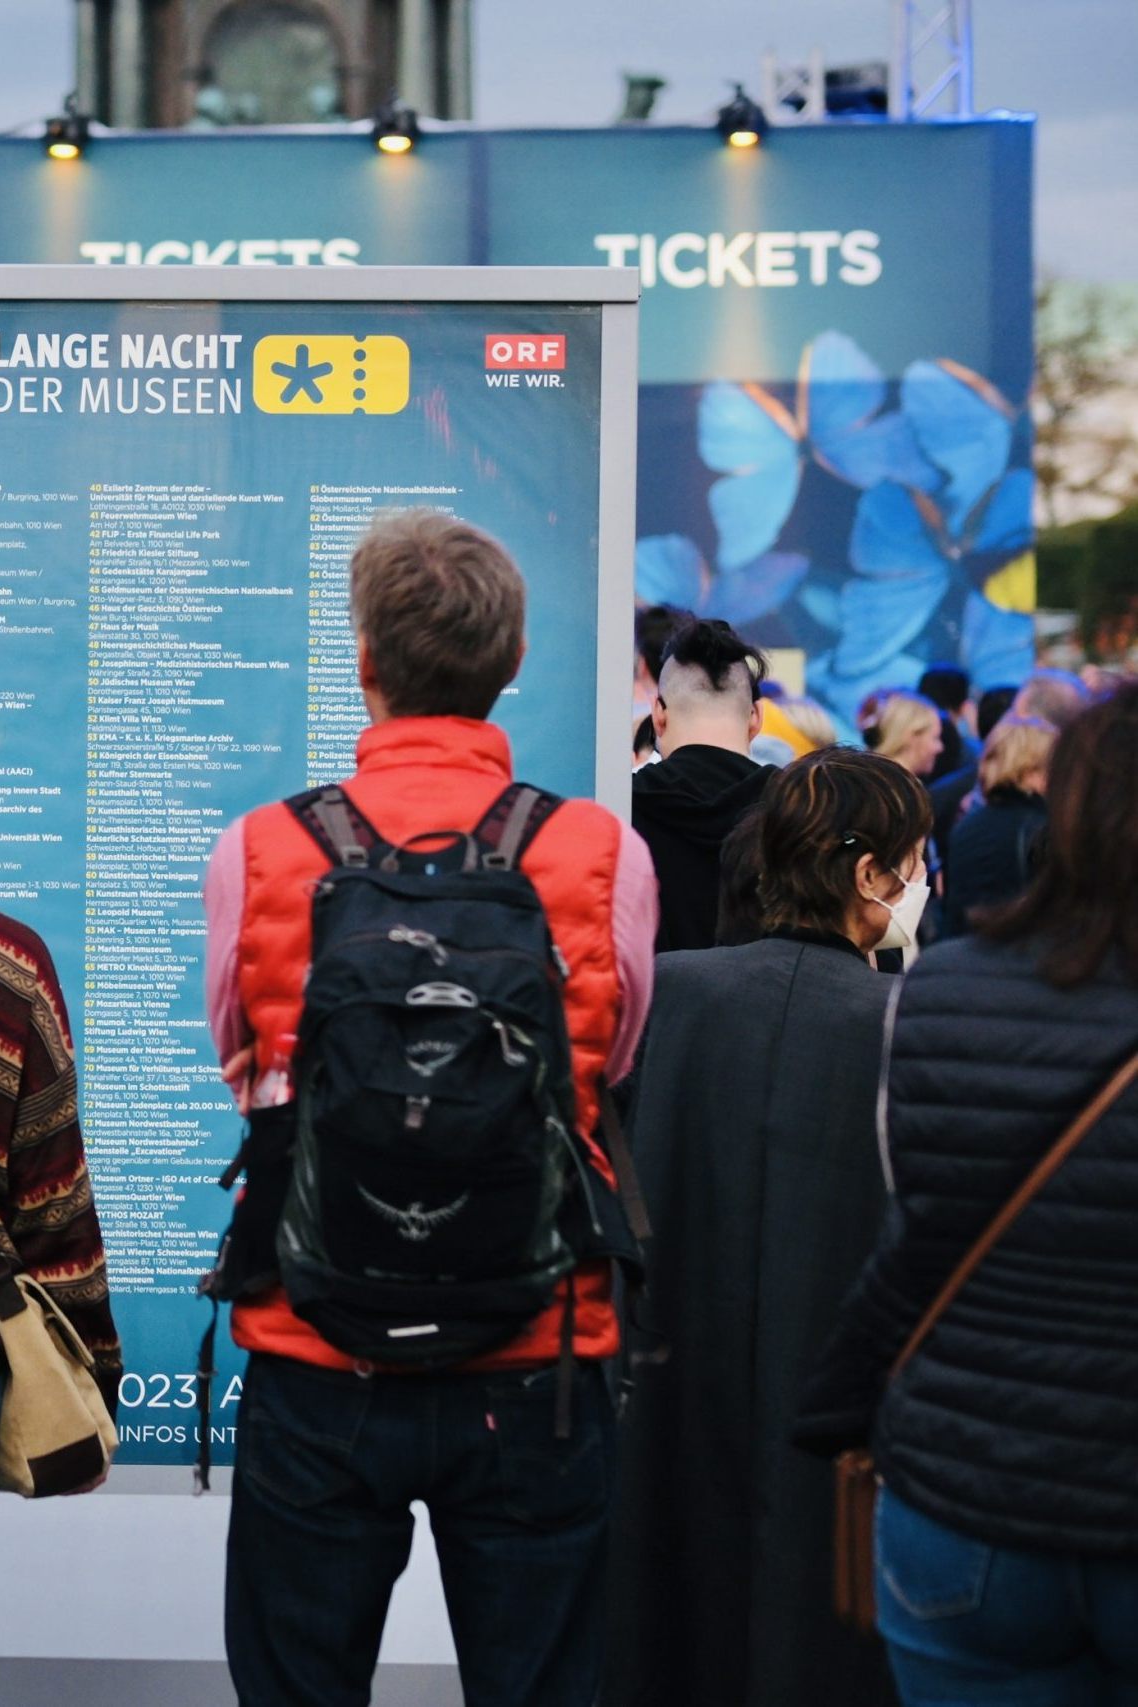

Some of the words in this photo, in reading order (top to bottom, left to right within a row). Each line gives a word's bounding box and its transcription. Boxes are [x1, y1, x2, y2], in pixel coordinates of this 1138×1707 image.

[593, 229, 883, 288] TICKETS
[121, 334, 242, 369] NACHT
[491, 341, 559, 363] ORF
[485, 374, 520, 388] WIE
[525, 374, 565, 388] WIR.
[79, 377, 242, 414] MUSEEN
[167, 549, 199, 558] Stiftung
[182, 603, 222, 612] Österreich
[149, 697, 175, 706] Joseph
[99, 752, 141, 761] Königreich
[151, 872, 198, 881] Vereinigung
[97, 908, 129, 917] Leopold
[130, 1102, 172, 1111] Judenplatz
[118, 1373, 197, 1409] 023
[219, 1375, 243, 1409] A
[120, 1425, 186, 1444] INFOS
